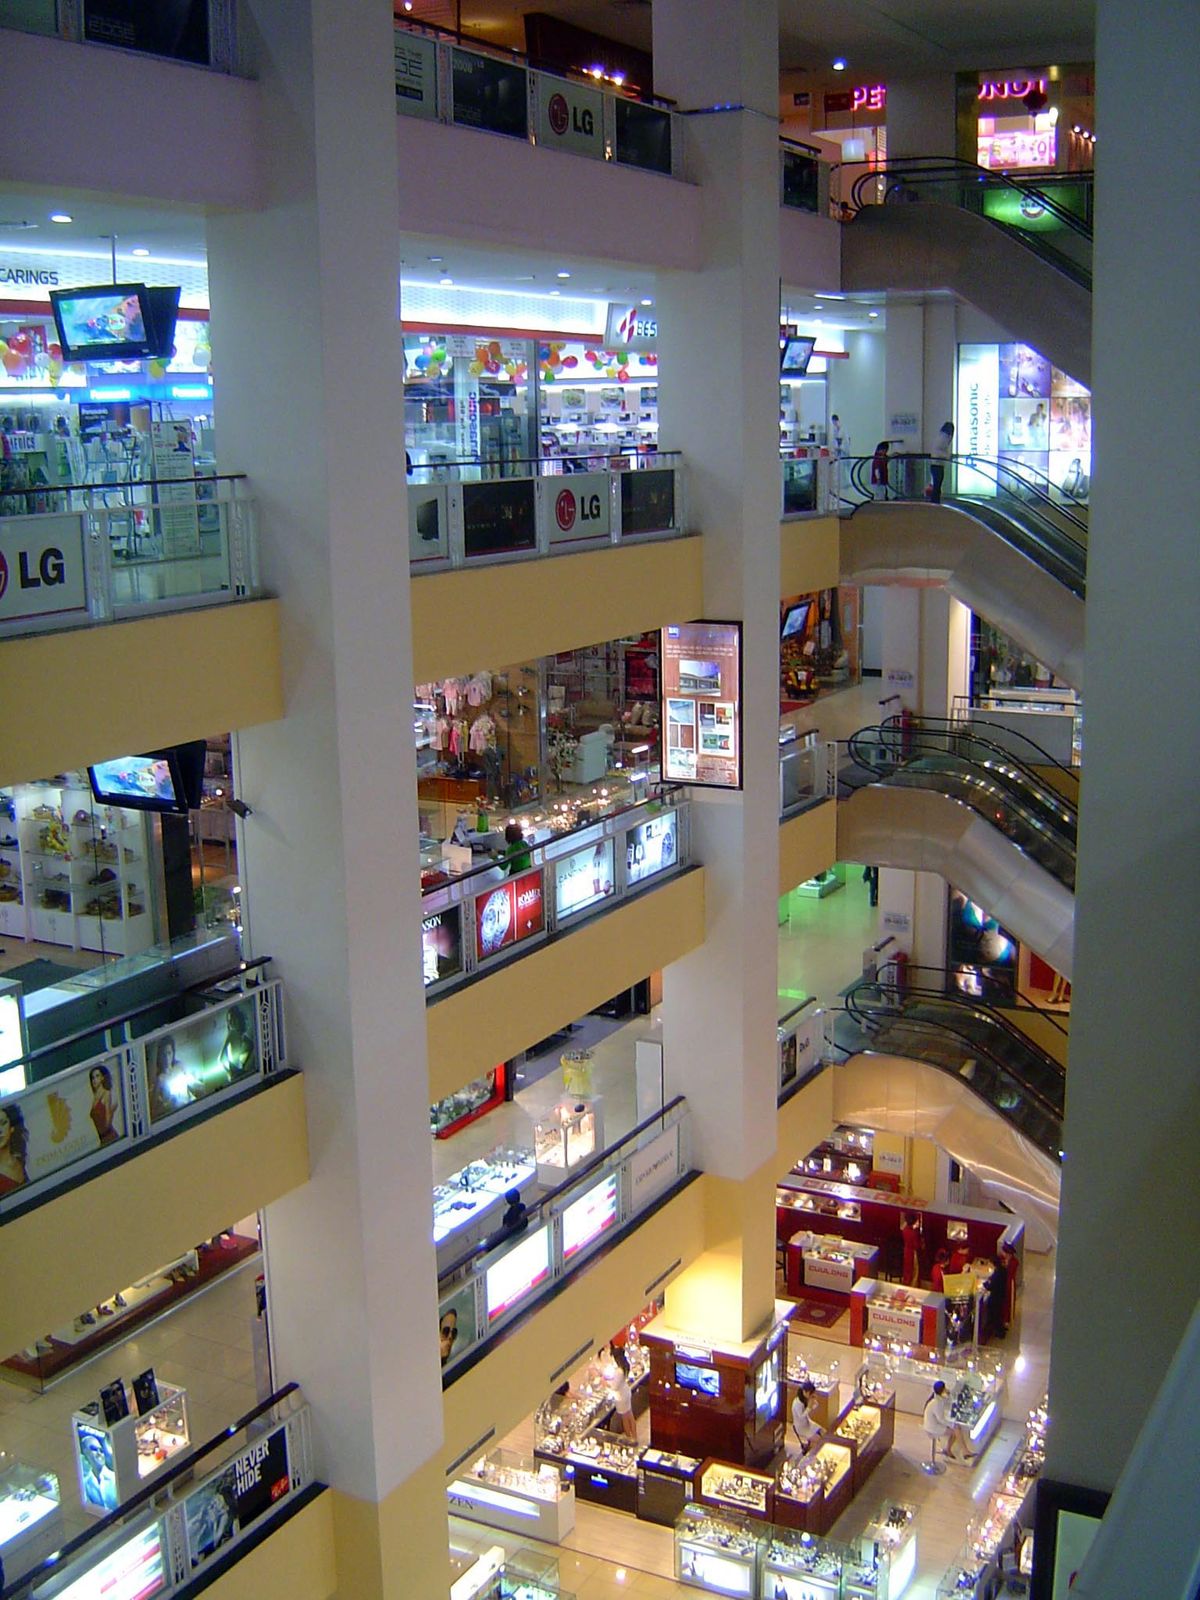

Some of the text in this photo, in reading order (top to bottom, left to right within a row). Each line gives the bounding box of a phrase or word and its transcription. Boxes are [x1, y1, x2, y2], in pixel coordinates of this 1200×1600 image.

[572, 106, 594, 136] LG
[0, 268, 59, 286] CARINGS
[965, 383, 979, 467] Panasonic
[580, 494, 601, 521] LG
[18, 547, 66, 589] LG
[235, 1439, 270, 1478] NEVER
[236, 1463, 262, 1496] HIDE
